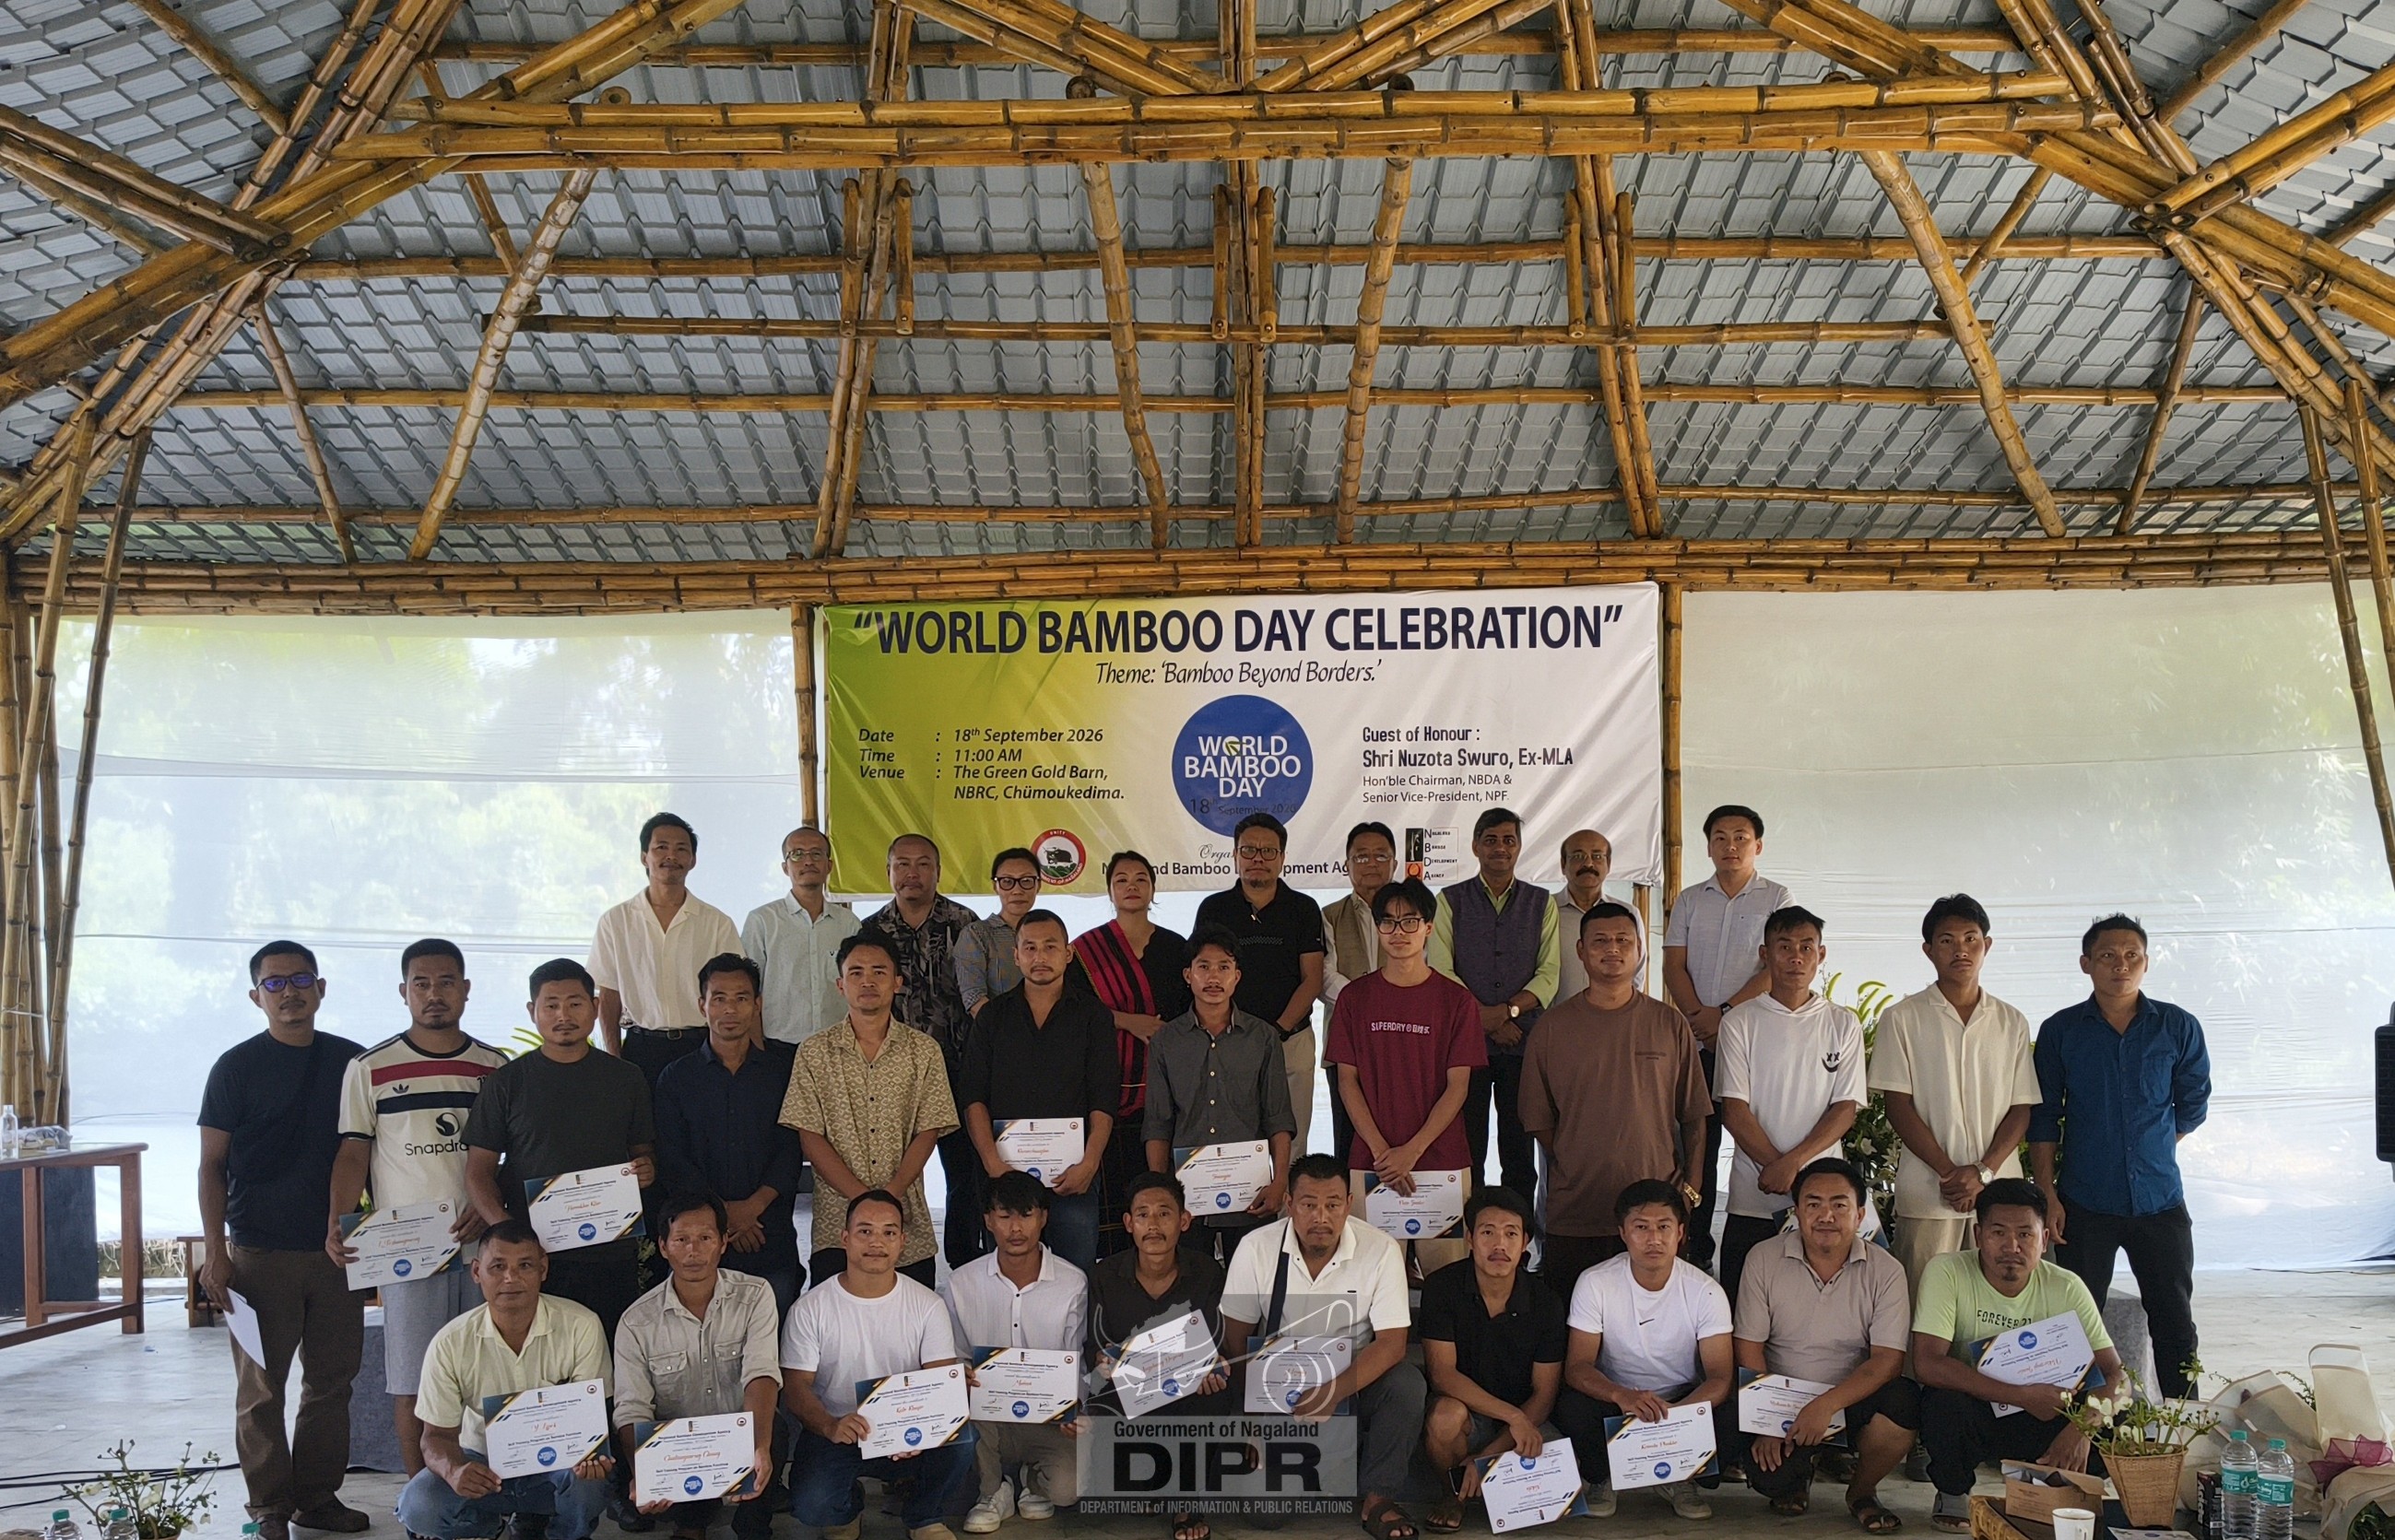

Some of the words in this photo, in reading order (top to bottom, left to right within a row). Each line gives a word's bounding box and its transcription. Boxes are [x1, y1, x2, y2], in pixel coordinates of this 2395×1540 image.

[1038, 609, 1223, 653] BAMBOO
[1234, 608, 1315, 652] DAY
[1325, 605, 1623, 651] CELEBRATION”
[1095, 662, 1156, 685] Theme:
[1238, 660, 1301, 688] Beyond
[858, 728, 894, 743] Date
[954, 728, 980, 743] 18th
[983, 728, 1064, 746] September
[1067, 728, 1103, 743] 2026
[1363, 726, 1401, 743] Guest
[1404, 726, 1421, 742] of
[1423, 726, 1472, 742] Honour
[1198, 735, 1288, 757] WORLD
[859, 748, 895, 763] Time
[953, 748, 994, 762] 11:00
[997, 748, 1022, 762] AM
[1363, 749, 1394, 768] Shri
[1398, 749, 1453, 768] Nuzota
[1457, 748, 1513, 770] Swuro,
[1518, 748, 1574, 766] Ex-MLA
[859, 765, 905, 780] Venue
[954, 765, 980, 779] The
[983, 765, 1028, 780] Green
[1031, 765, 1067, 780] Gold
[1069, 765, 1108, 782] Barn,
[1185, 755, 1302, 778] BAMBOO
[1219, 777, 1267, 798] DAY
[1409, 774, 1466, 787] Chairman,
[1469, 774, 1501, 785] NBDA
[1504, 774, 1513, 784] &
[953, 785, 998, 801] NBRC,
[1002, 783, 1125, 800] Chümoukedima.
[1363, 792, 1398, 804] Senior
[1400, 790, 1482, 804] Vice-President,
[1174, 863, 1231, 875] Bamboo
[405, 1139, 469, 1156] Snapdra
[1976, 1310, 2020, 1330] FOREVER
